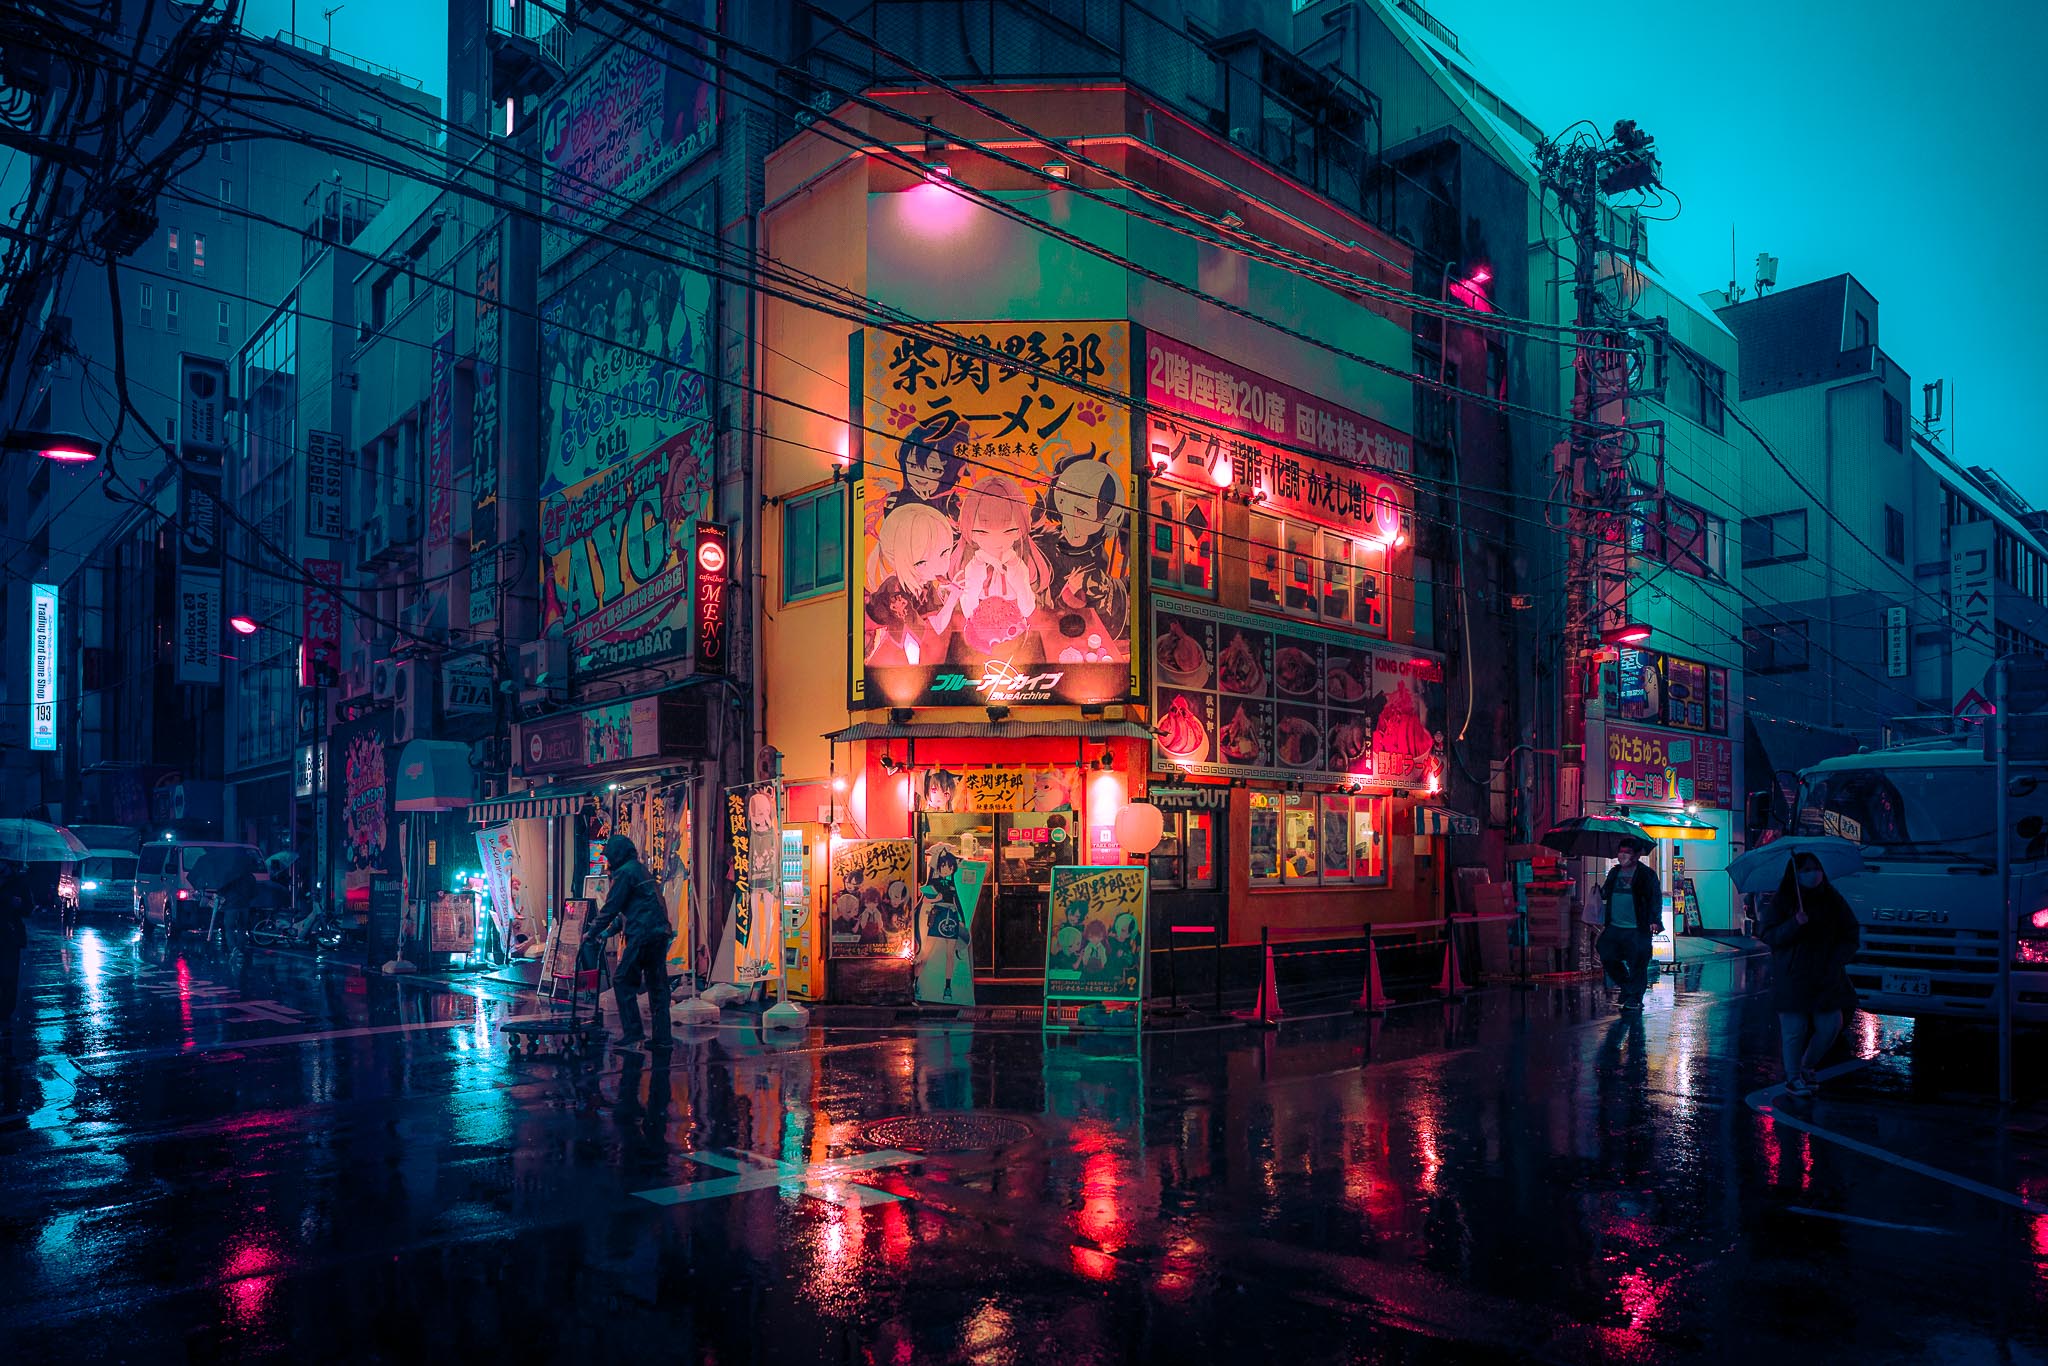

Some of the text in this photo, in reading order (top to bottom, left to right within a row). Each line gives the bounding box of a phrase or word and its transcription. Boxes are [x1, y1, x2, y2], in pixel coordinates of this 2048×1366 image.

[889, 331, 1105, 394] 柴関野郎
[560, 369, 676, 465] eternal
[920, 394, 1077, 442] ラーメン
[1150, 346, 1409, 472] 2階座敷20席 団体様大歓迎
[595, 424, 629, 464] 6th
[955, 443, 1040, 458] 秋葉原総本店
[308, 434, 325, 496] BORDER
[325, 435, 342, 535] ACROSS THE
[544, 503, 567, 543] 2F
[184, 612, 196, 664] TwinBox
[196, 592, 208, 666] AKIHABARA
[700, 584, 723, 658] MENU
[36, 603, 47, 699] Trading Card Game Shop
[930, 669, 1064, 692] ブルーアーカイブ
[1375, 657, 1444, 684] KING OF RAMEN
[36, 705, 51, 721] 193
[1378, 750, 1445, 779] 野郎ラーメン
[1609, 733, 1667, 768] おたちゅう。
[965, 773, 1024, 789] 柴関野郎
[974, 790, 1016, 803] ラーメン
[1150, 786, 1229, 809] TAKE OUT
[1626, 771, 1664, 799] カード館
[833, 843, 897, 877] 柴関野郎
[865, 857, 912, 880] ラーメン
[1056, 873, 1126, 908] 柴関野郎
[1091, 887, 1142, 912] ラーメン
